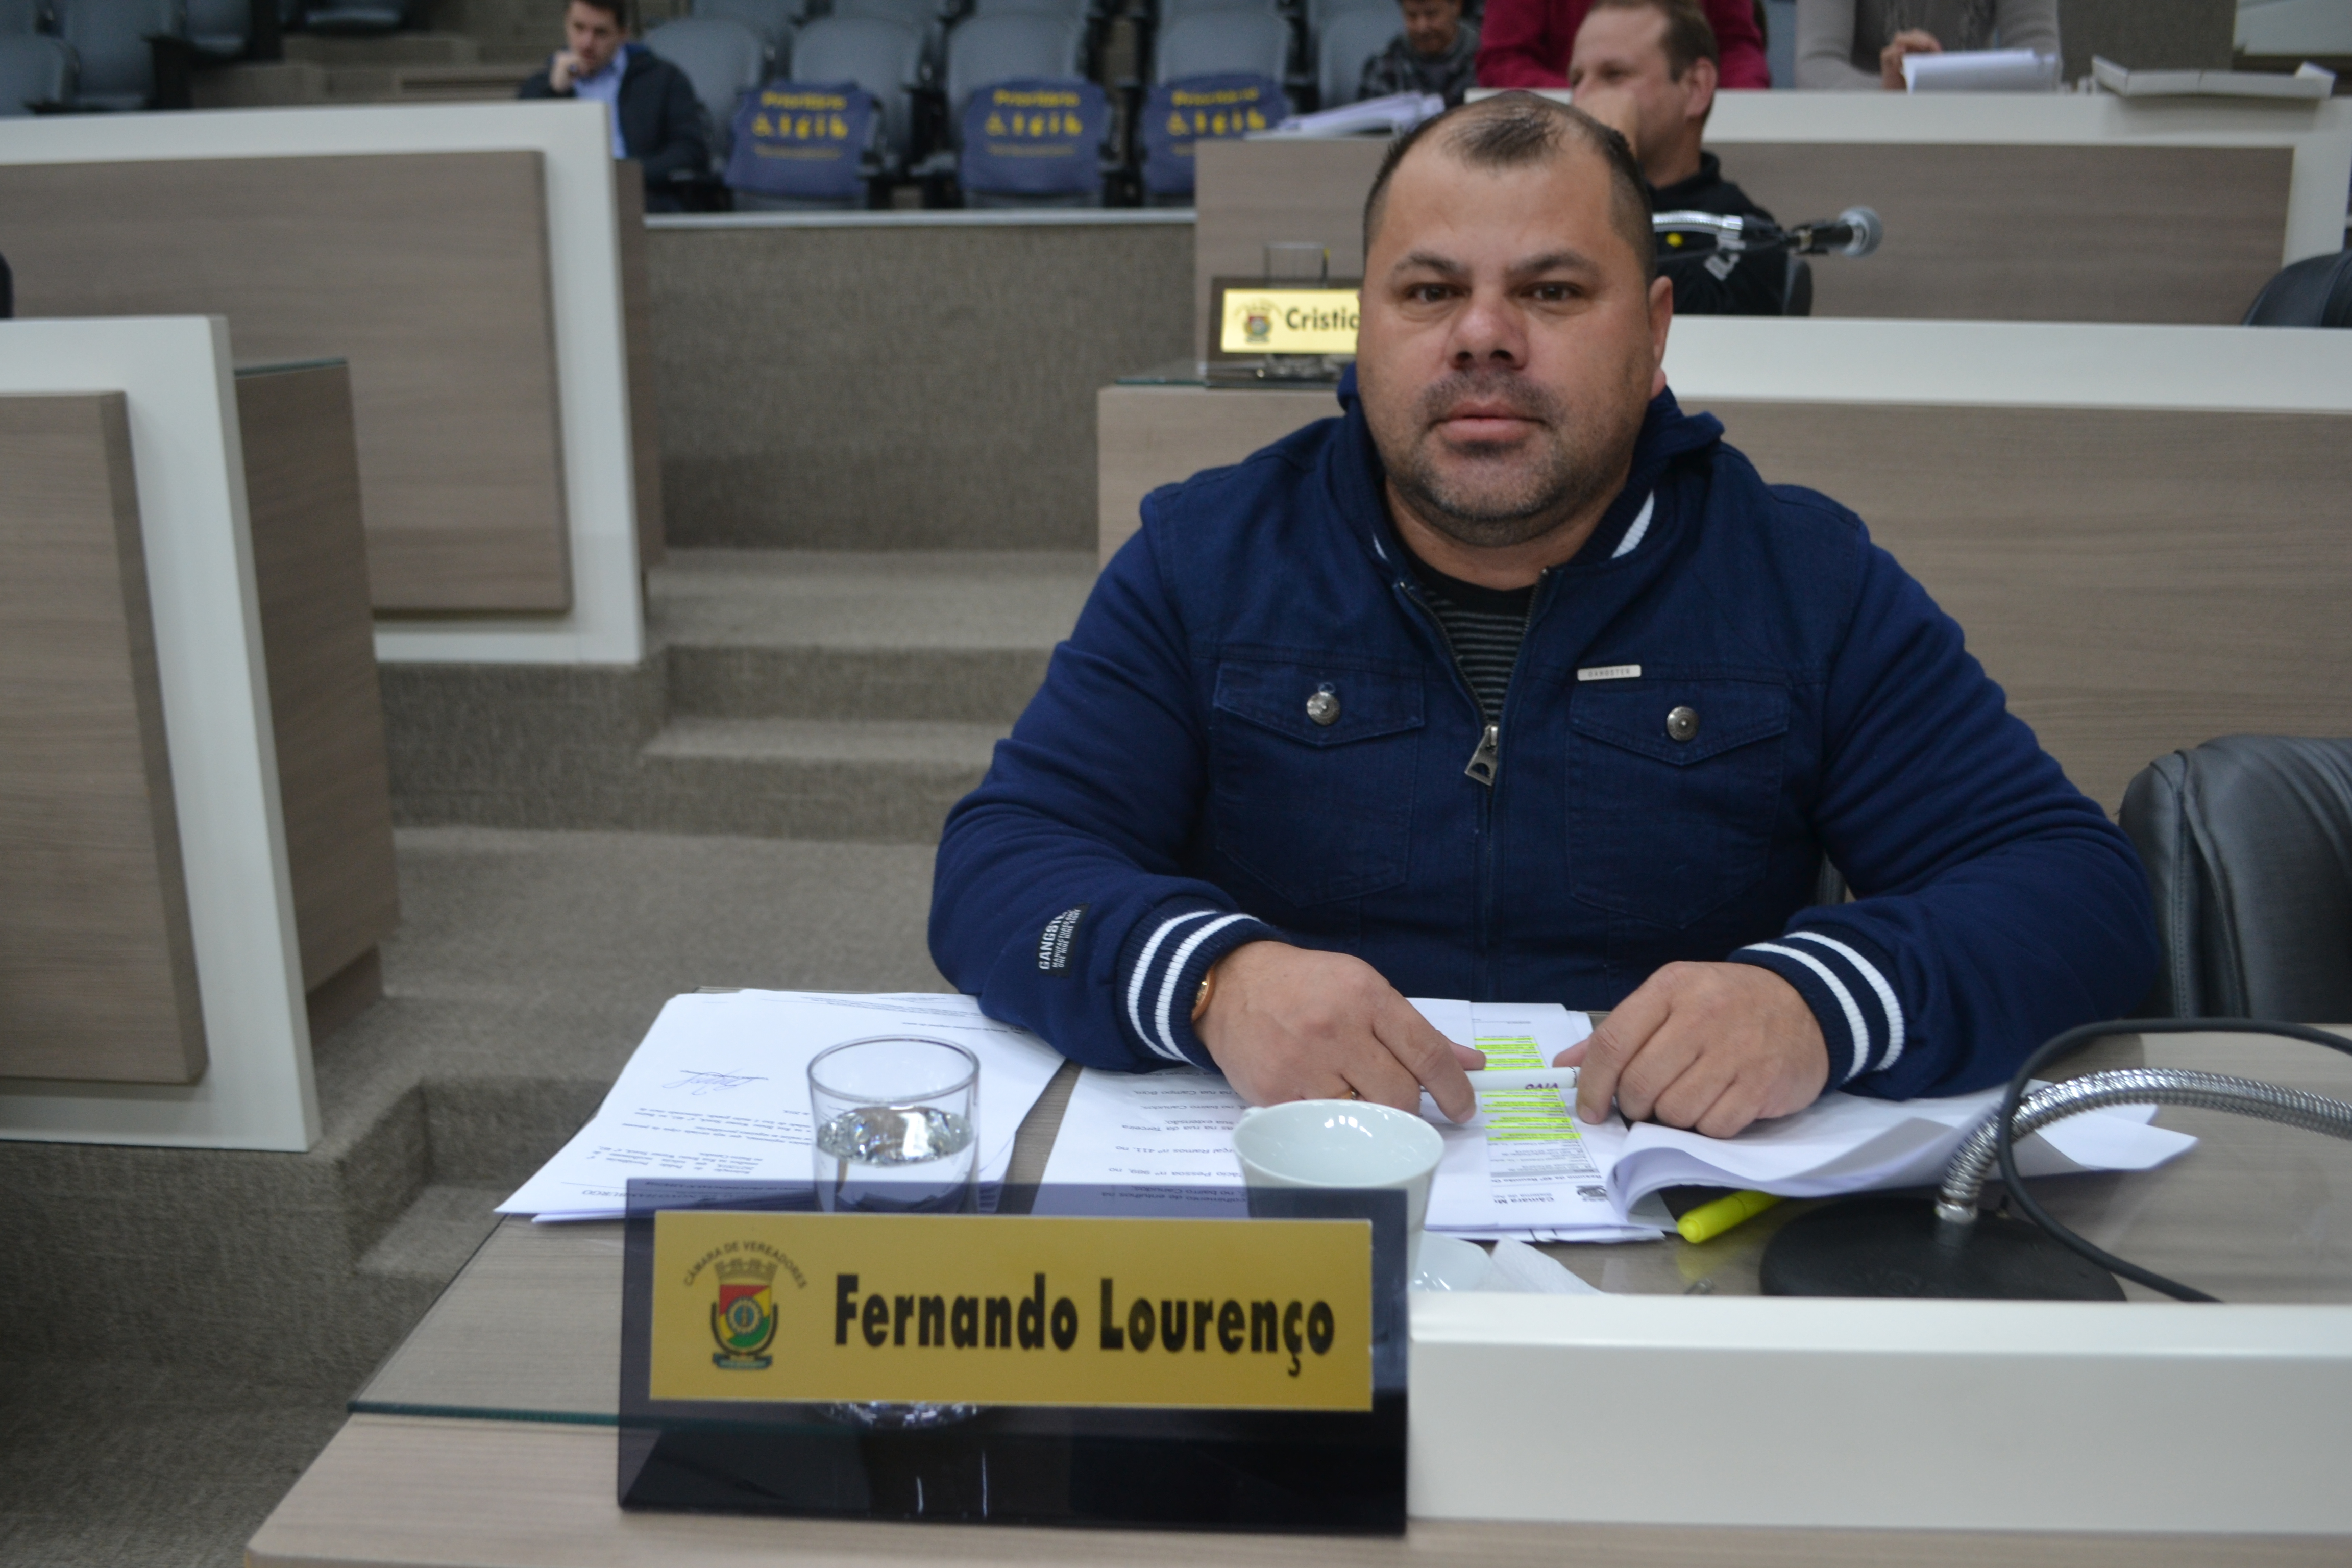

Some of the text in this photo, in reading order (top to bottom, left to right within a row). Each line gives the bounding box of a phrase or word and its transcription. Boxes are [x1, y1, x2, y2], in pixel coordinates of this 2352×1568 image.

[1588, 669, 1630, 677] GANGSTER
[724, 1242, 738, 1253] DE
[744, 1241, 807, 1288] VEREADORES
[836, 1272, 1334, 1378] Fernando Lourenço
